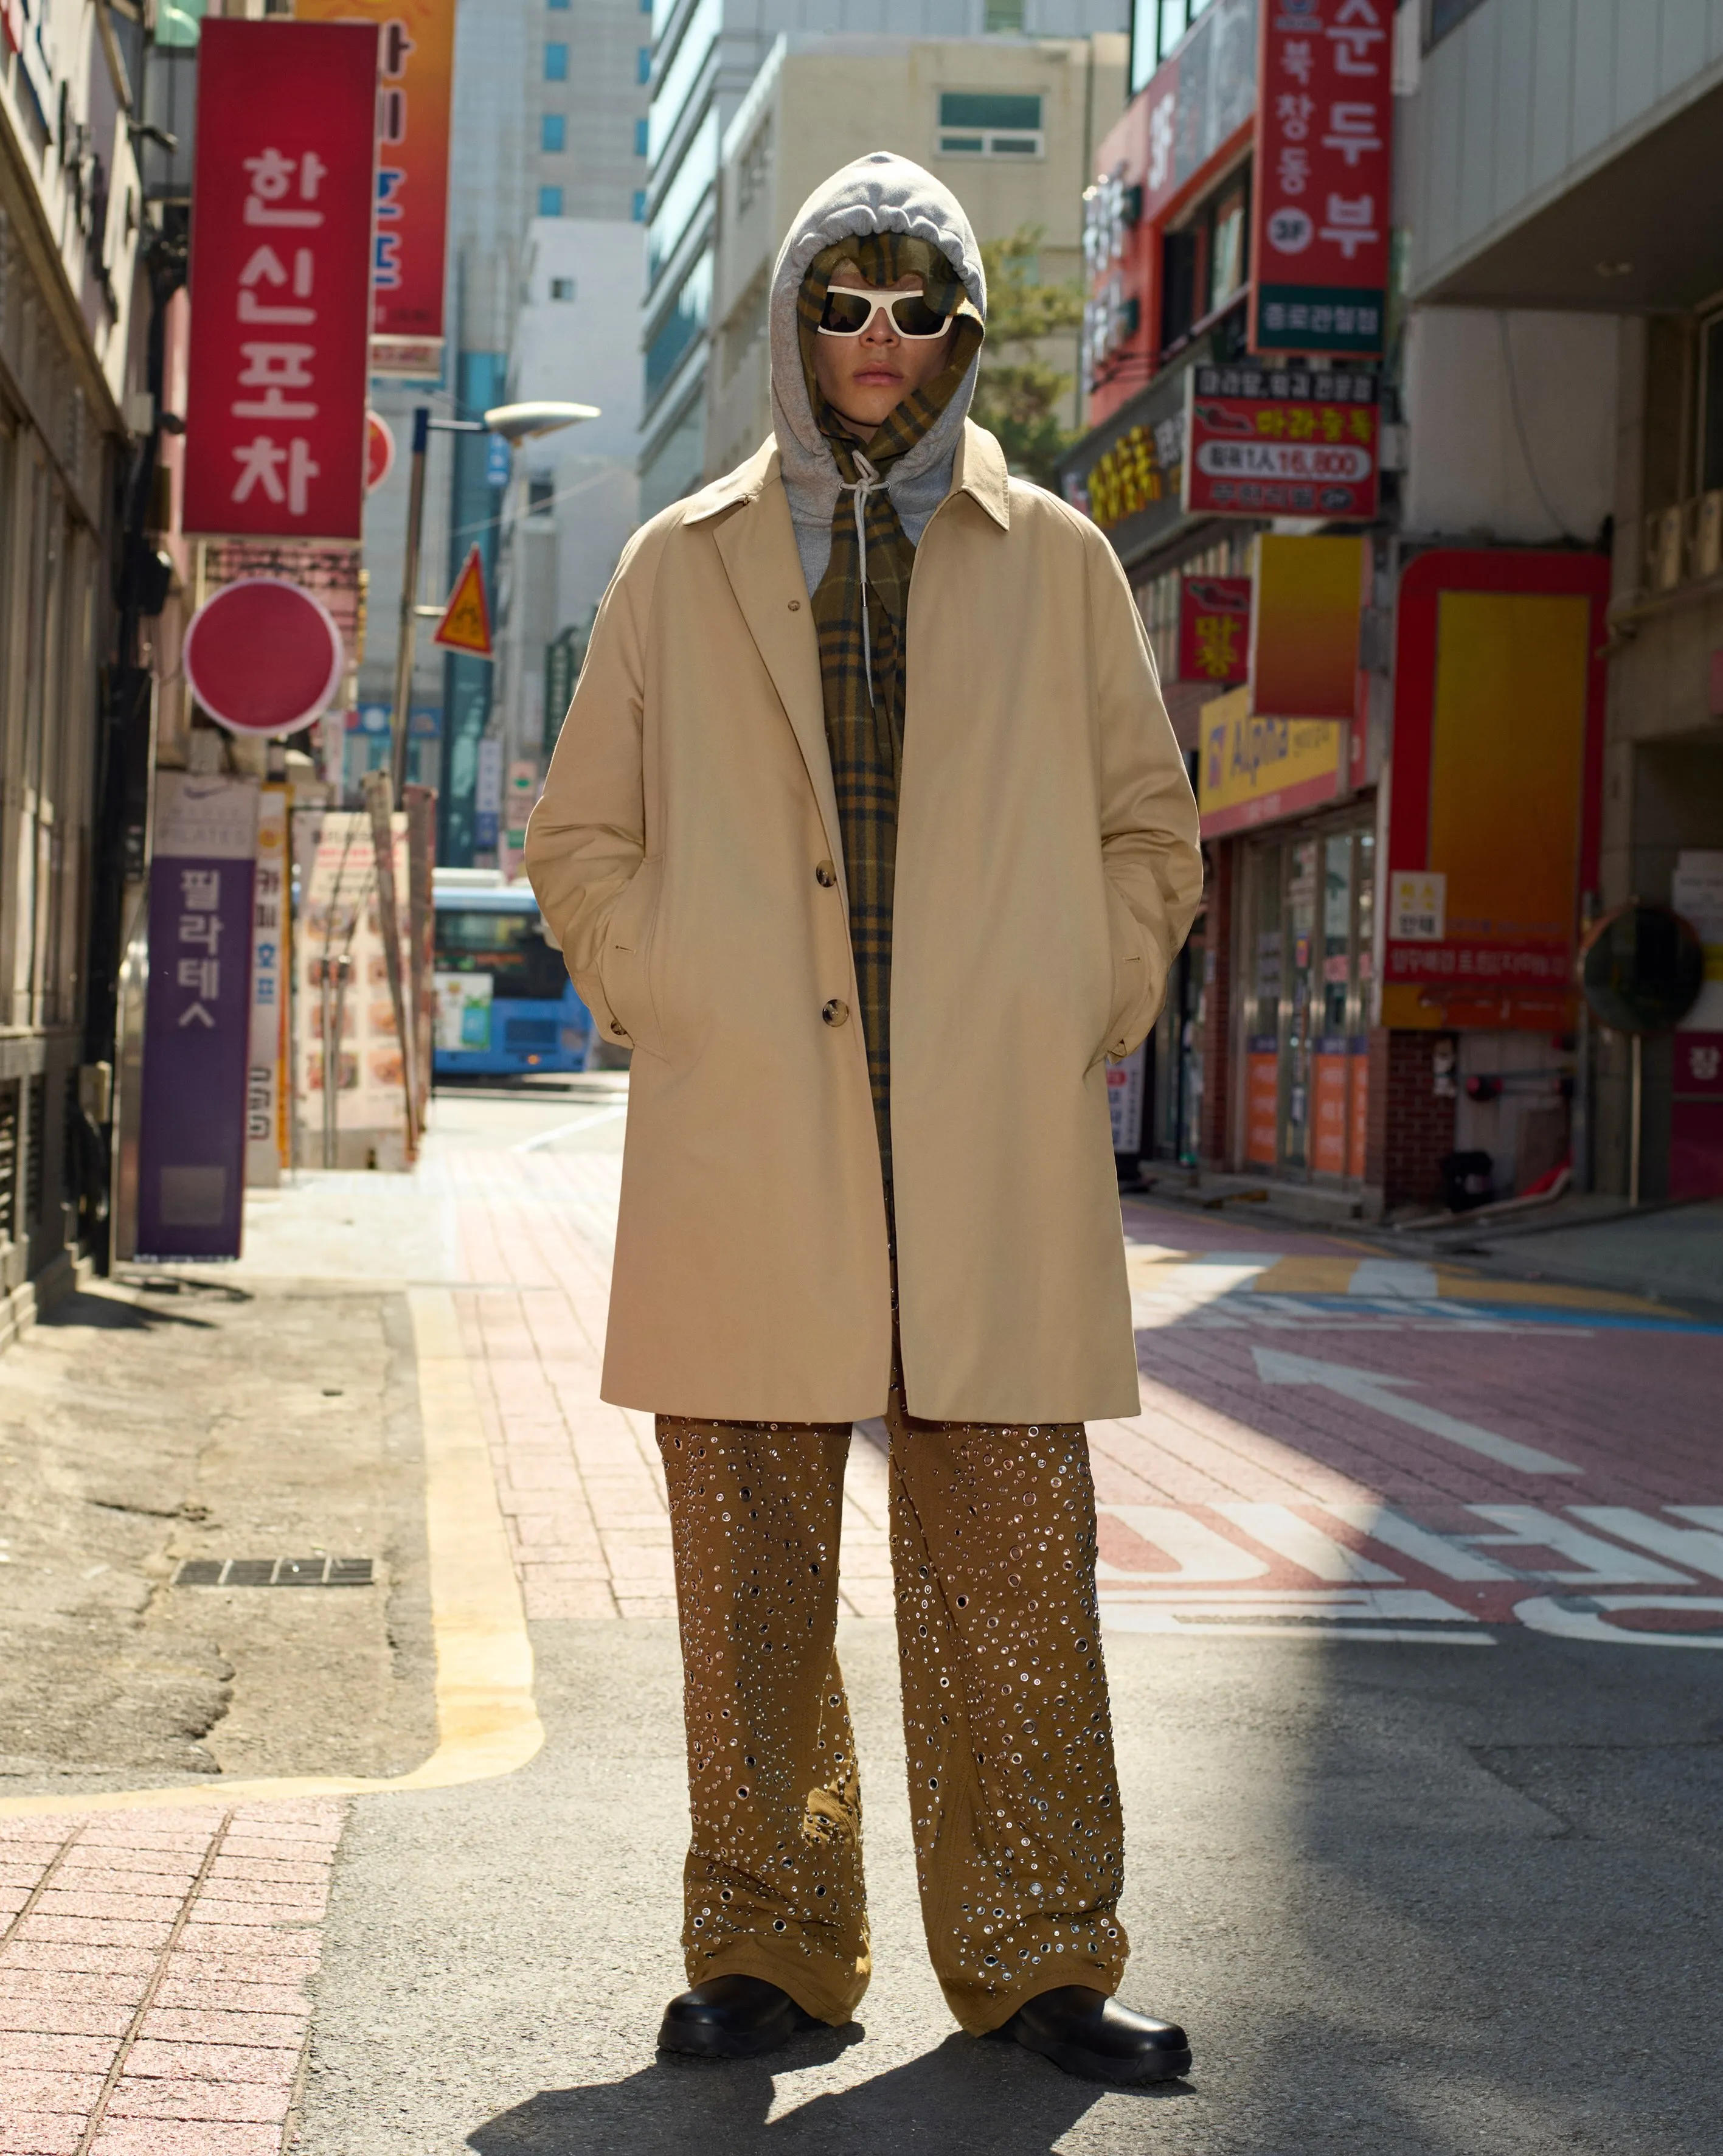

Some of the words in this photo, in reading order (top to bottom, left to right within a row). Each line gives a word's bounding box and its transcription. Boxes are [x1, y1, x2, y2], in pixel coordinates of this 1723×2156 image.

[1275, 41, 1316, 195] 북창동
[1319, 0, 1385, 259] 순두부
[231, 148, 327, 515] 한신포차
